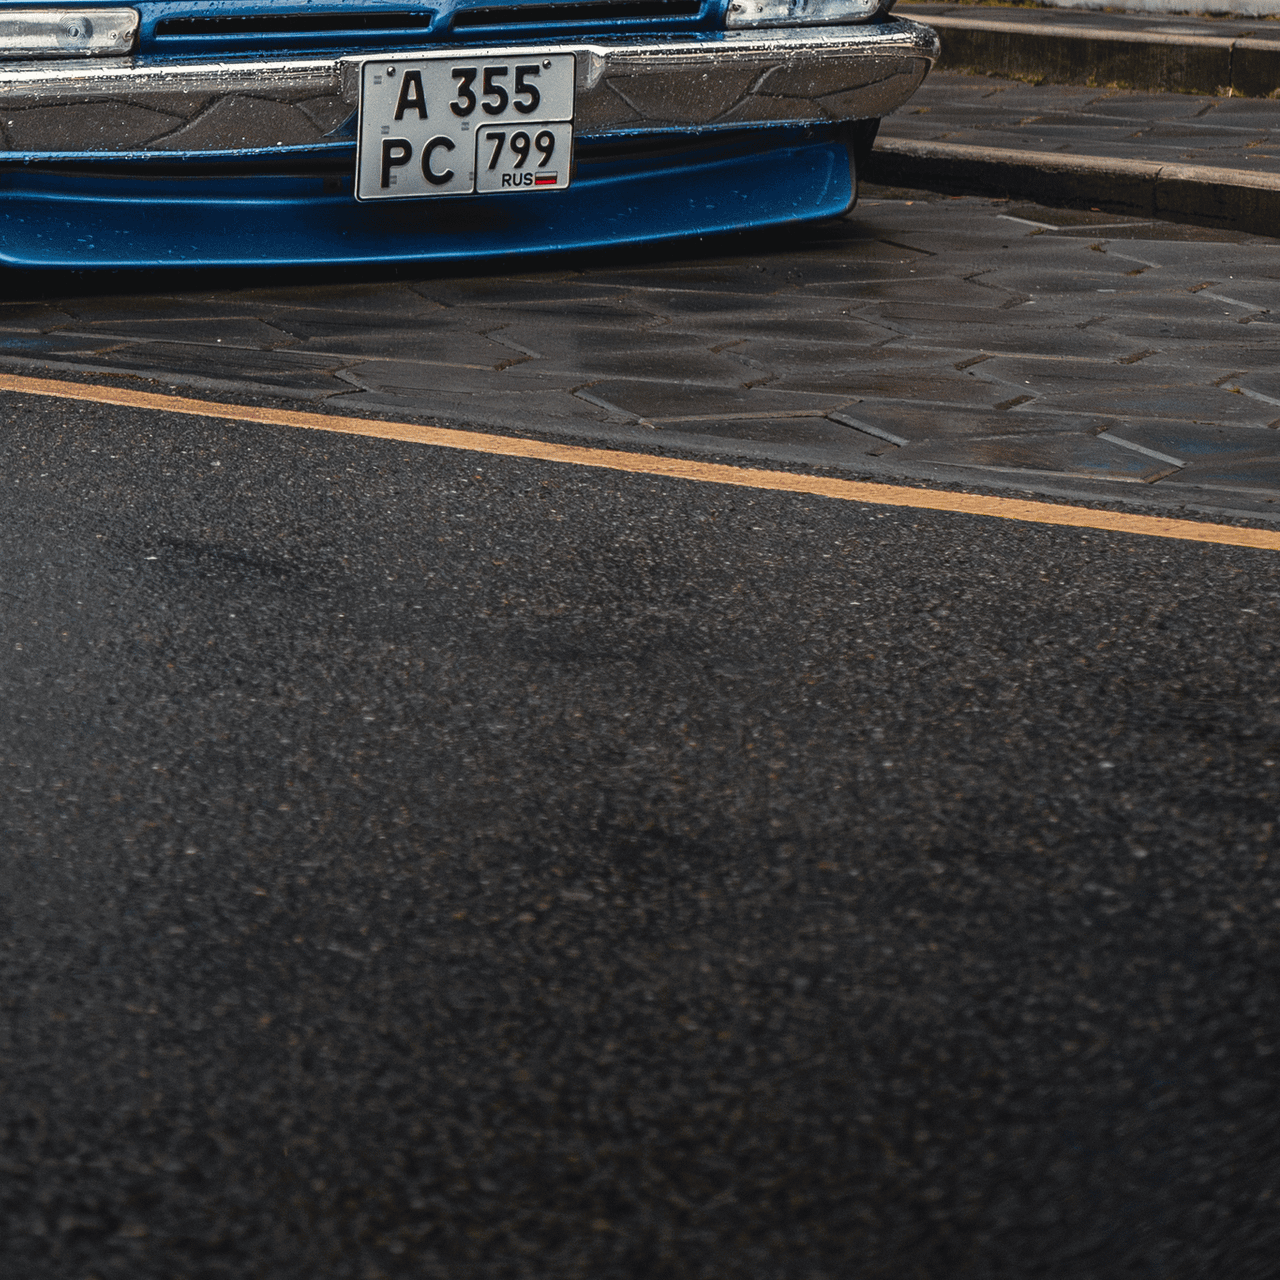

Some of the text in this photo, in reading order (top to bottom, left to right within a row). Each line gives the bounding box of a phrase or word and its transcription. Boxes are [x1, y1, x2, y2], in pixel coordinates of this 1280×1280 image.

[449, 64, 541, 117] 355
[485, 129, 556, 170] 799
[501, 172, 534, 188] RUS
